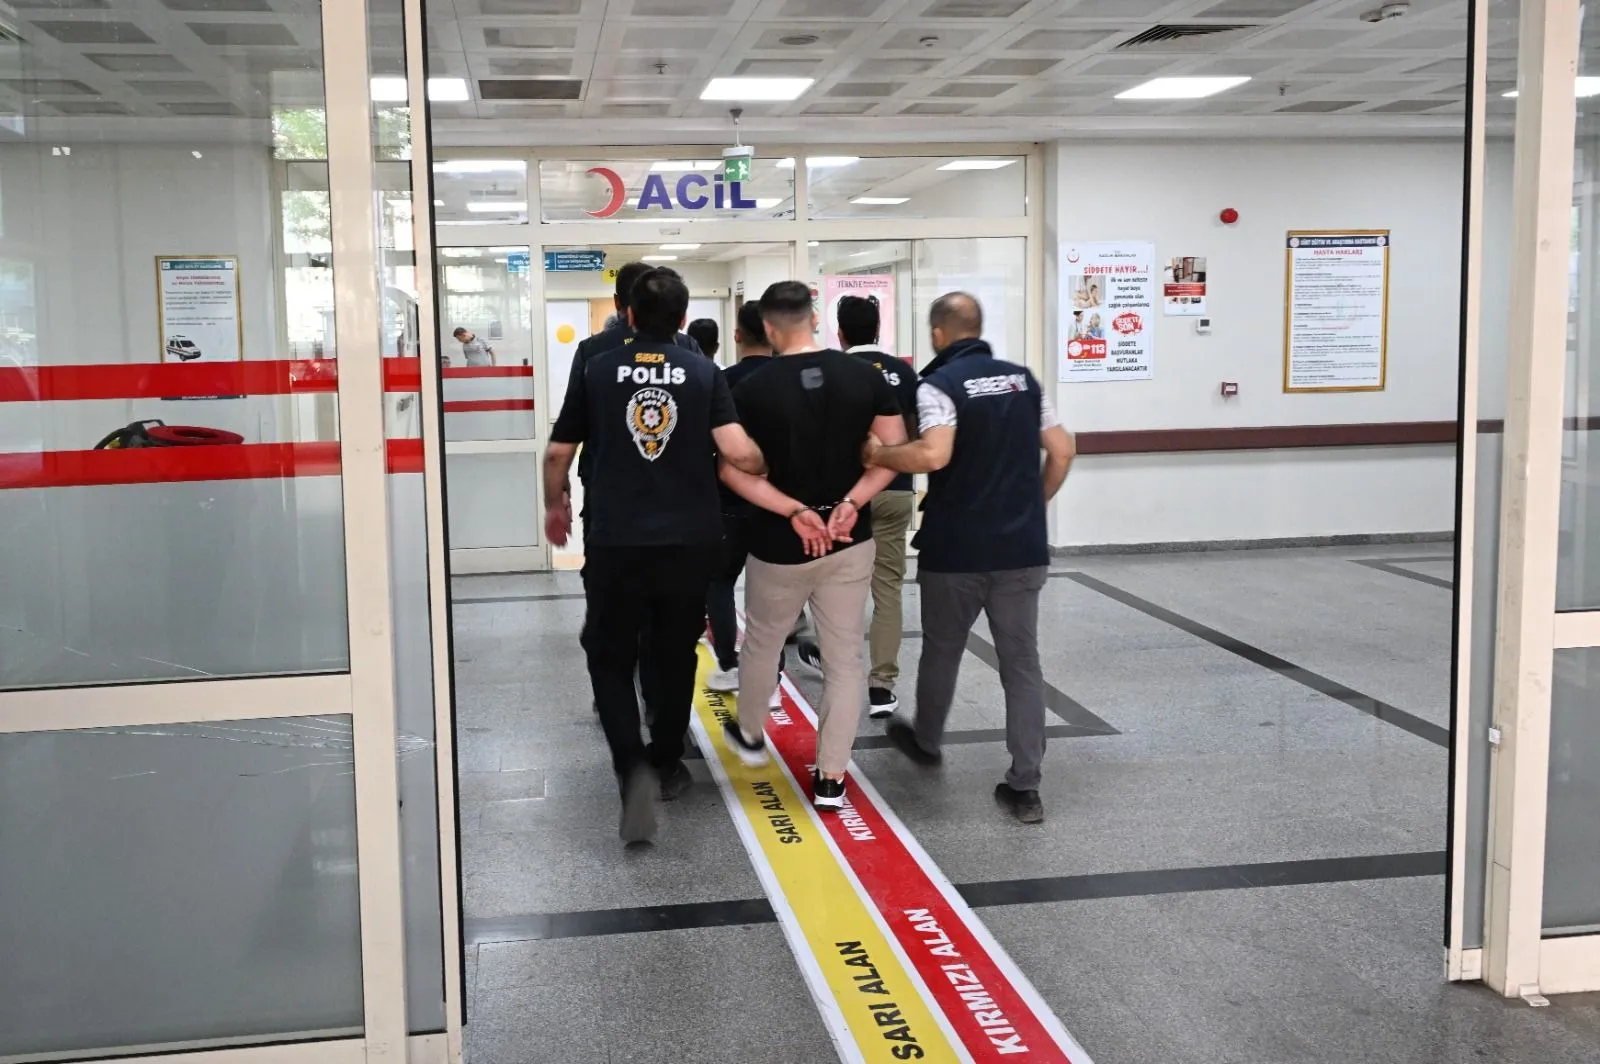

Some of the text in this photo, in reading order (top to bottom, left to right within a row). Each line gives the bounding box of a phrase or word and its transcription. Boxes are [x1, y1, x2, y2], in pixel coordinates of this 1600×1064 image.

[616, 362, 687, 385] POLİS
[1091, 343, 1105, 354] 113
[751, 781, 802, 844] SARI ALAN
[836, 940, 925, 1061] SARI ALAN
[904, 908, 1030, 1055] KIRMIZI ALAN
